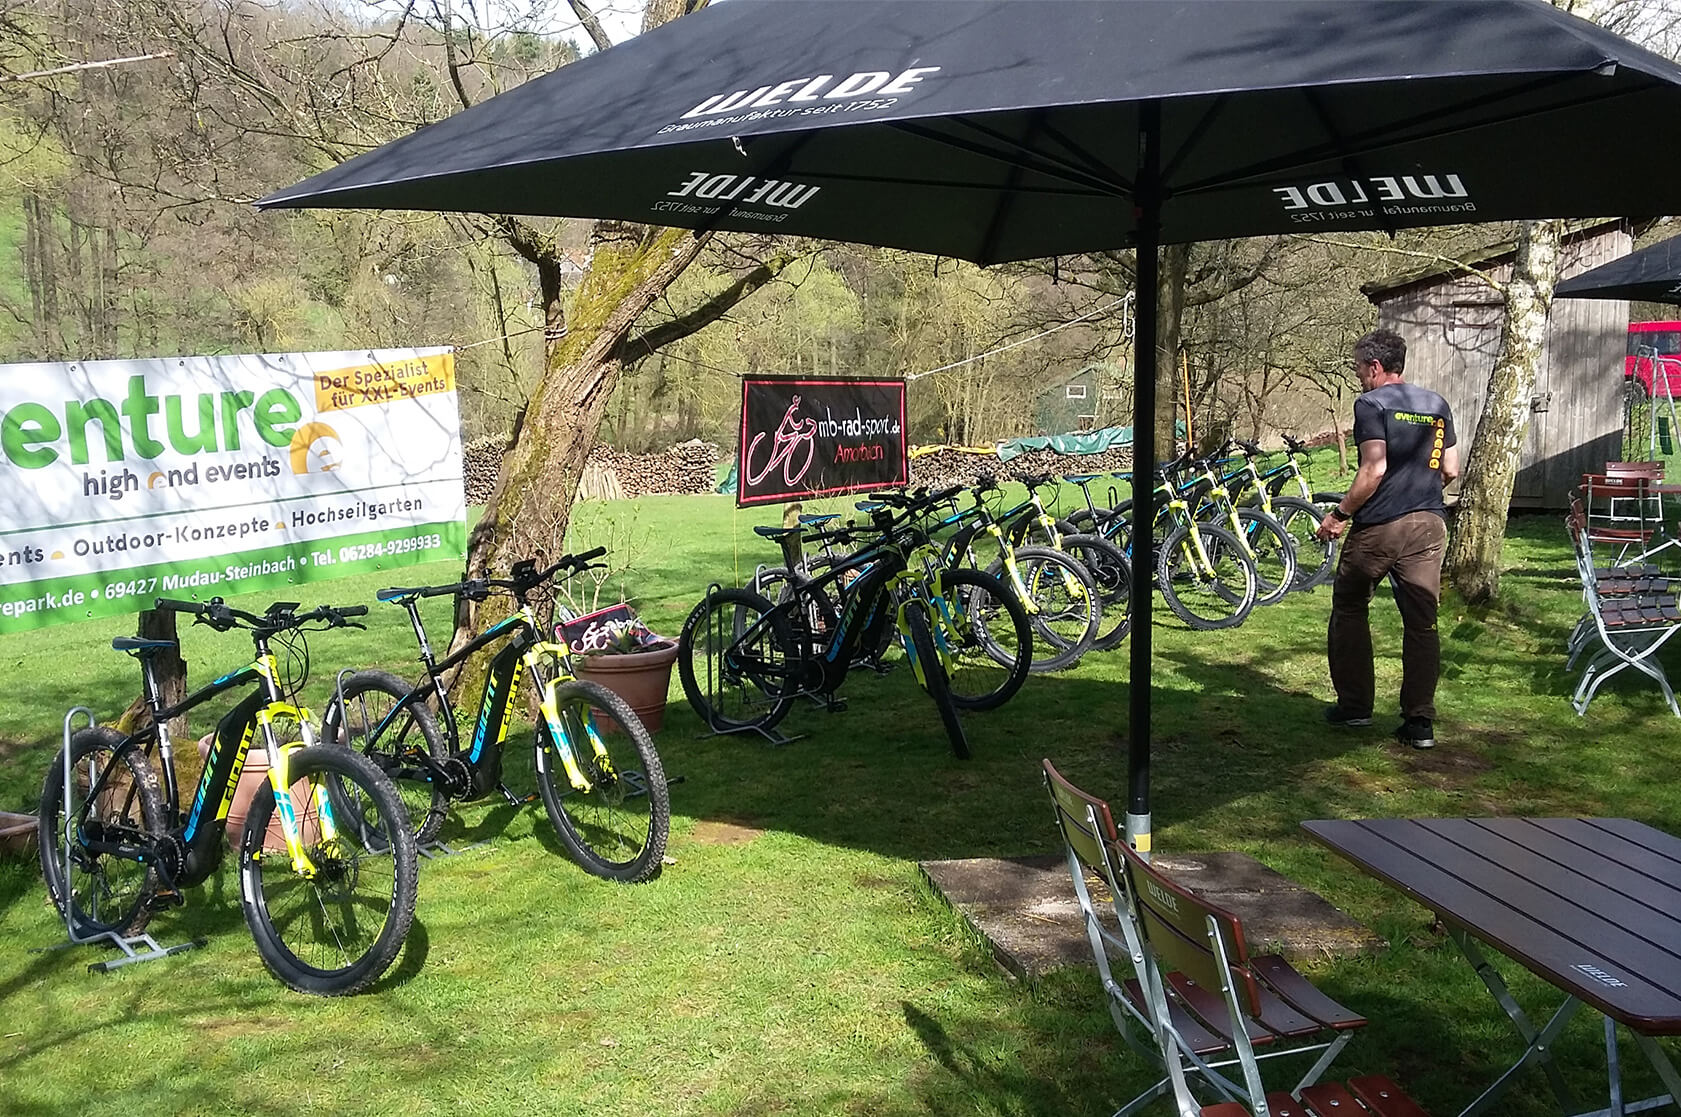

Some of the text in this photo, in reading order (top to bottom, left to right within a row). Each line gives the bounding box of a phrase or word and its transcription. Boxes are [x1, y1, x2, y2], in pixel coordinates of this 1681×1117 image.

[680, 66, 941, 119] WELDE
[657, 98, 898, 134] Braumanufaktur seit 1752
[320, 361, 429, 391] Der Spezialist
[332, 377, 447, 408] für XXL-Events
[818, 405, 900, 440] mb-rad-sport.de
[83, 468, 139, 500] high
[205, 455, 281, 482] events
[73, 516, 270, 557] Outdoor-Konzepte
[292, 496, 423, 528] Hochseilgarten
[0, 534, 442, 618] epark.de 69427 Mudau-Steinbach Tel. 06284-9299933
[190, 731, 222, 824] GIANT
